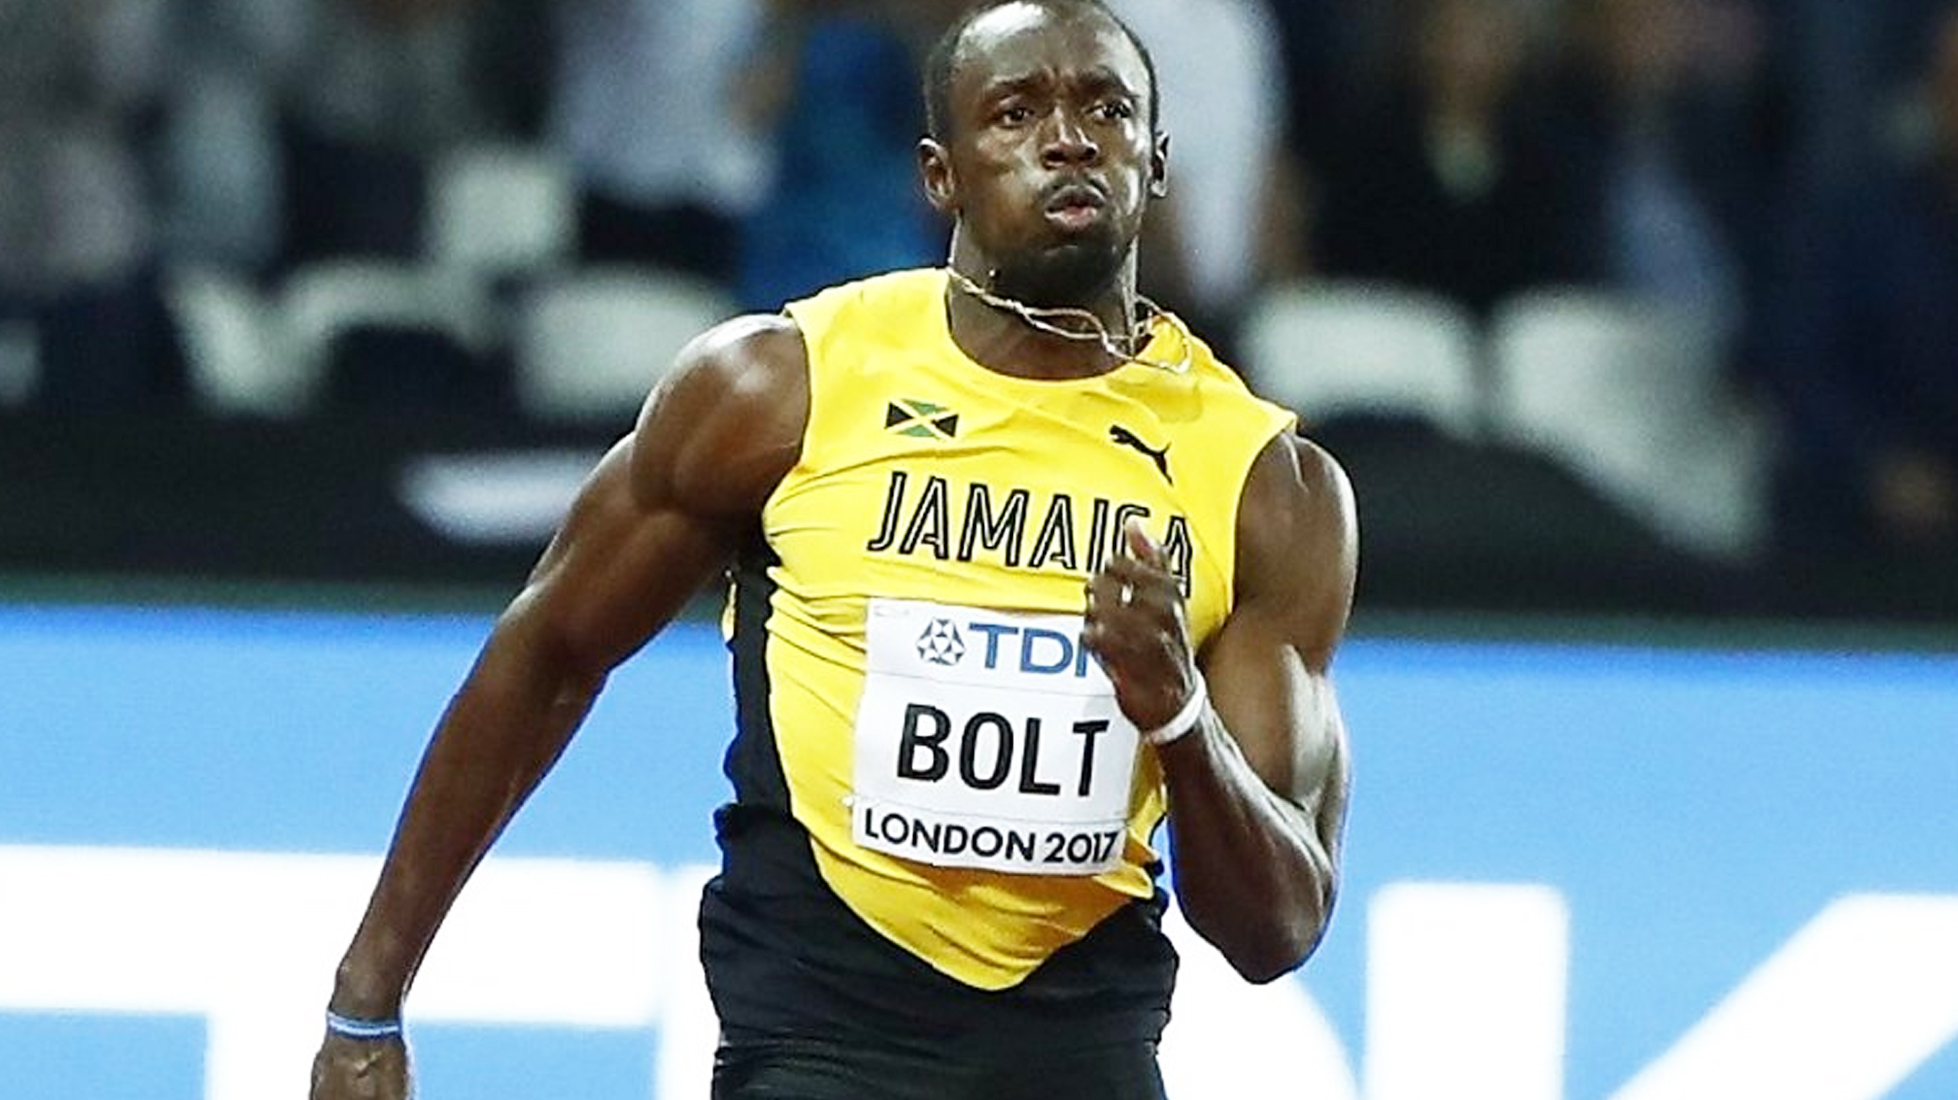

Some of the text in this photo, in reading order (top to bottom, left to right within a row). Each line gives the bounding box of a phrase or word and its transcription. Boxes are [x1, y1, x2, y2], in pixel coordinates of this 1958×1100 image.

[896, 702, 1110, 797] BOLT
[864, 807, 1119, 865] LONDON 2017
